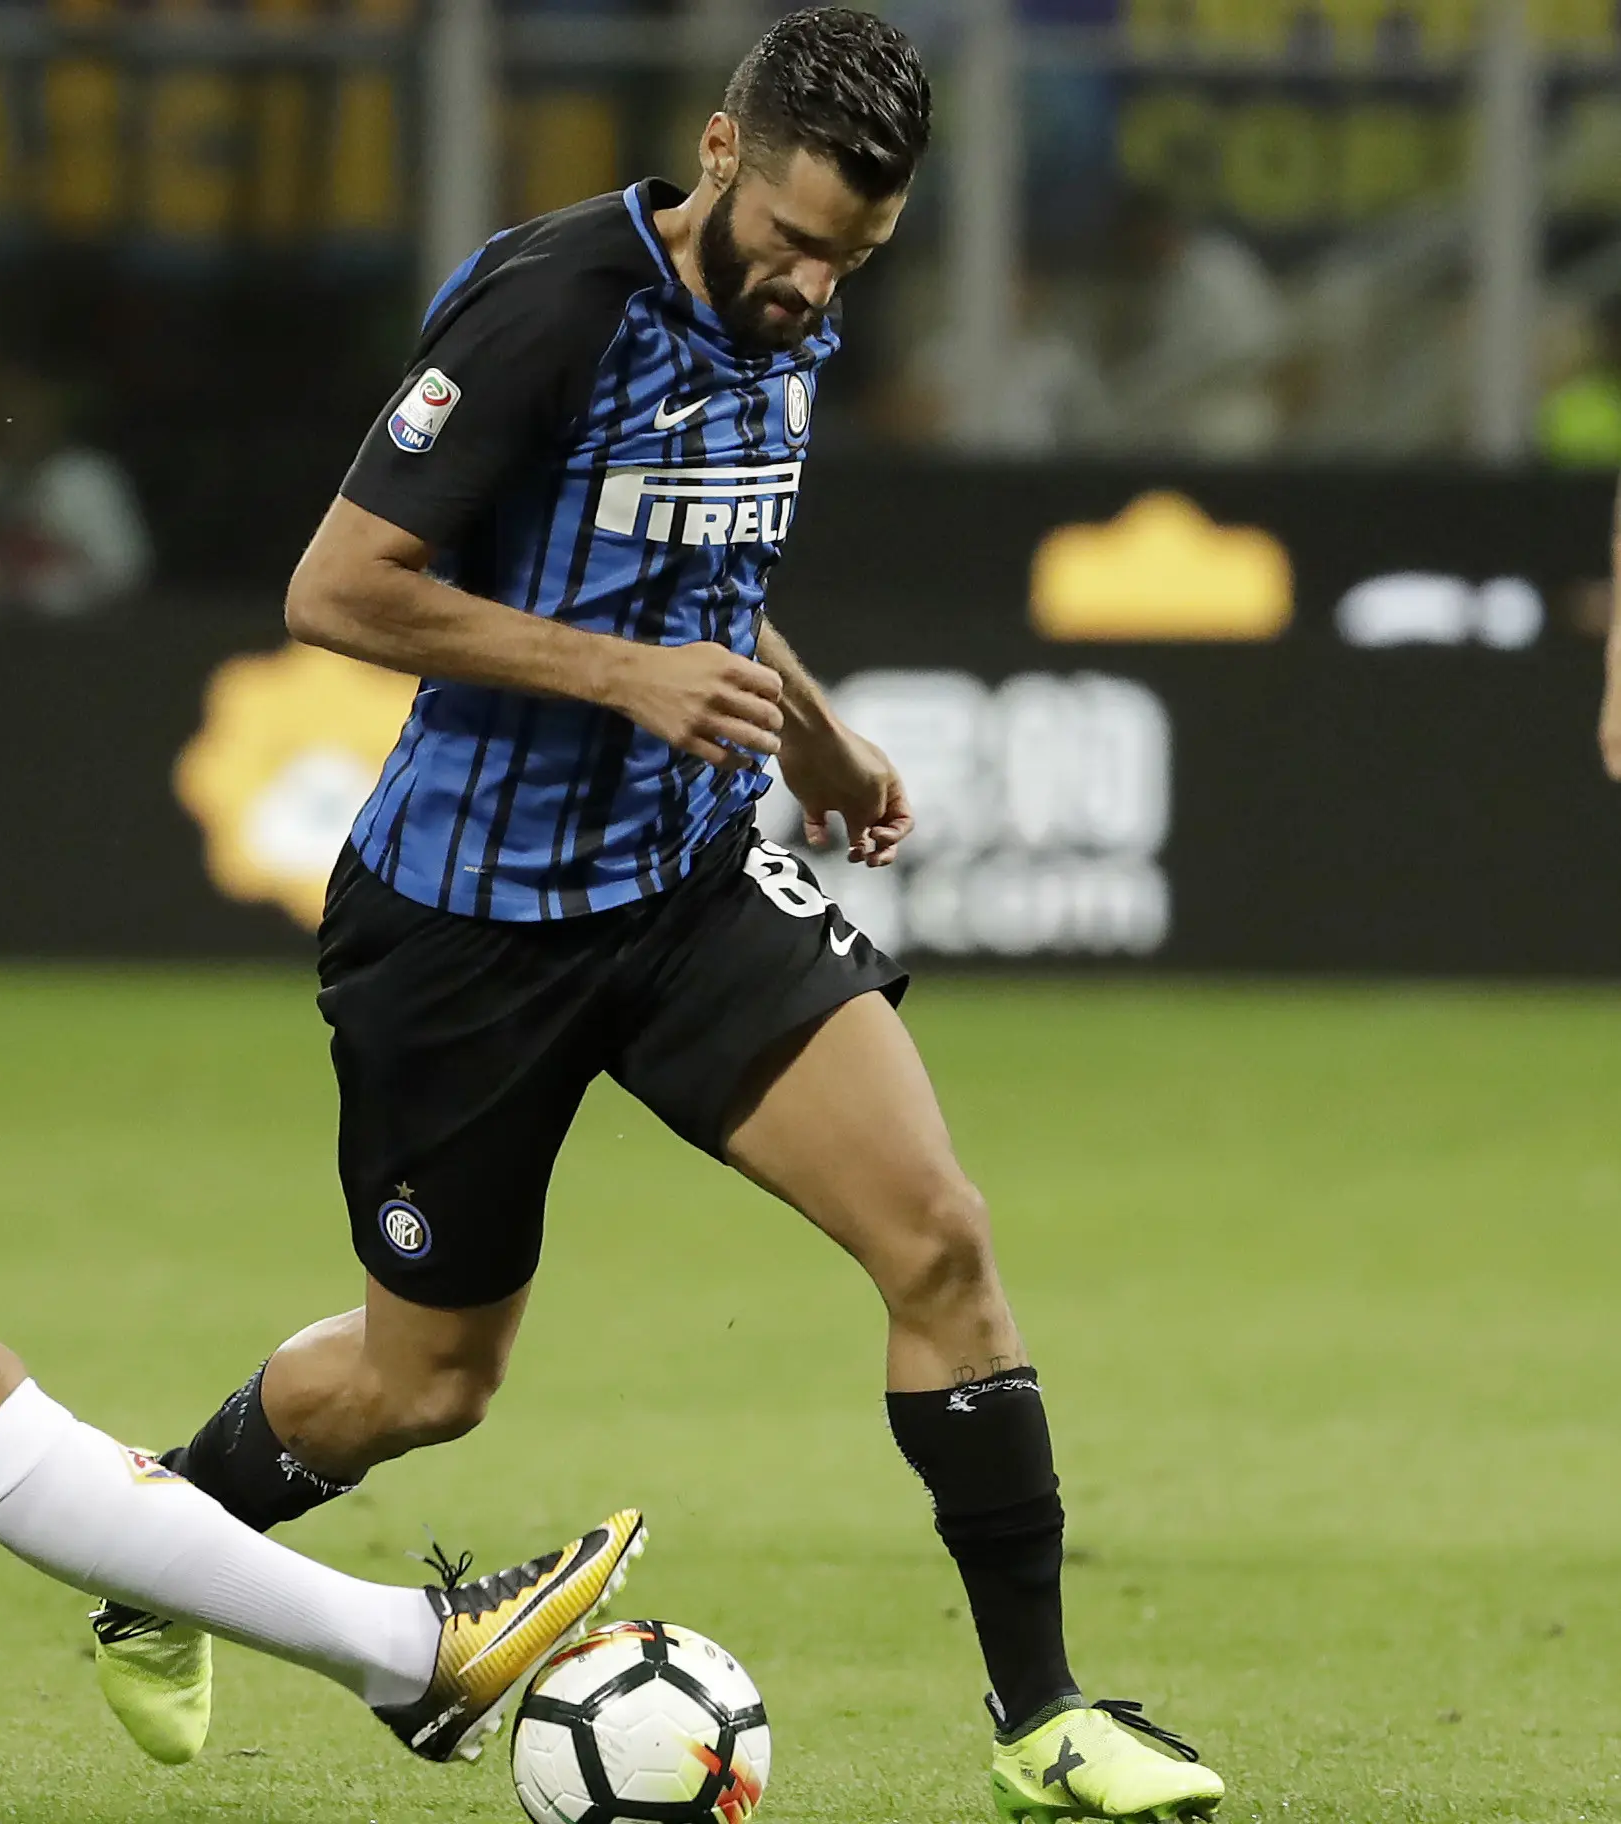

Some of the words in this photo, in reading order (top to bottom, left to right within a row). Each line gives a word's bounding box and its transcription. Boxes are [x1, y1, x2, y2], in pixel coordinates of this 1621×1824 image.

[401, 425, 426, 447] TIM
[594, 461, 802, 546] PIRELL
[743, 839, 836, 918] 8
